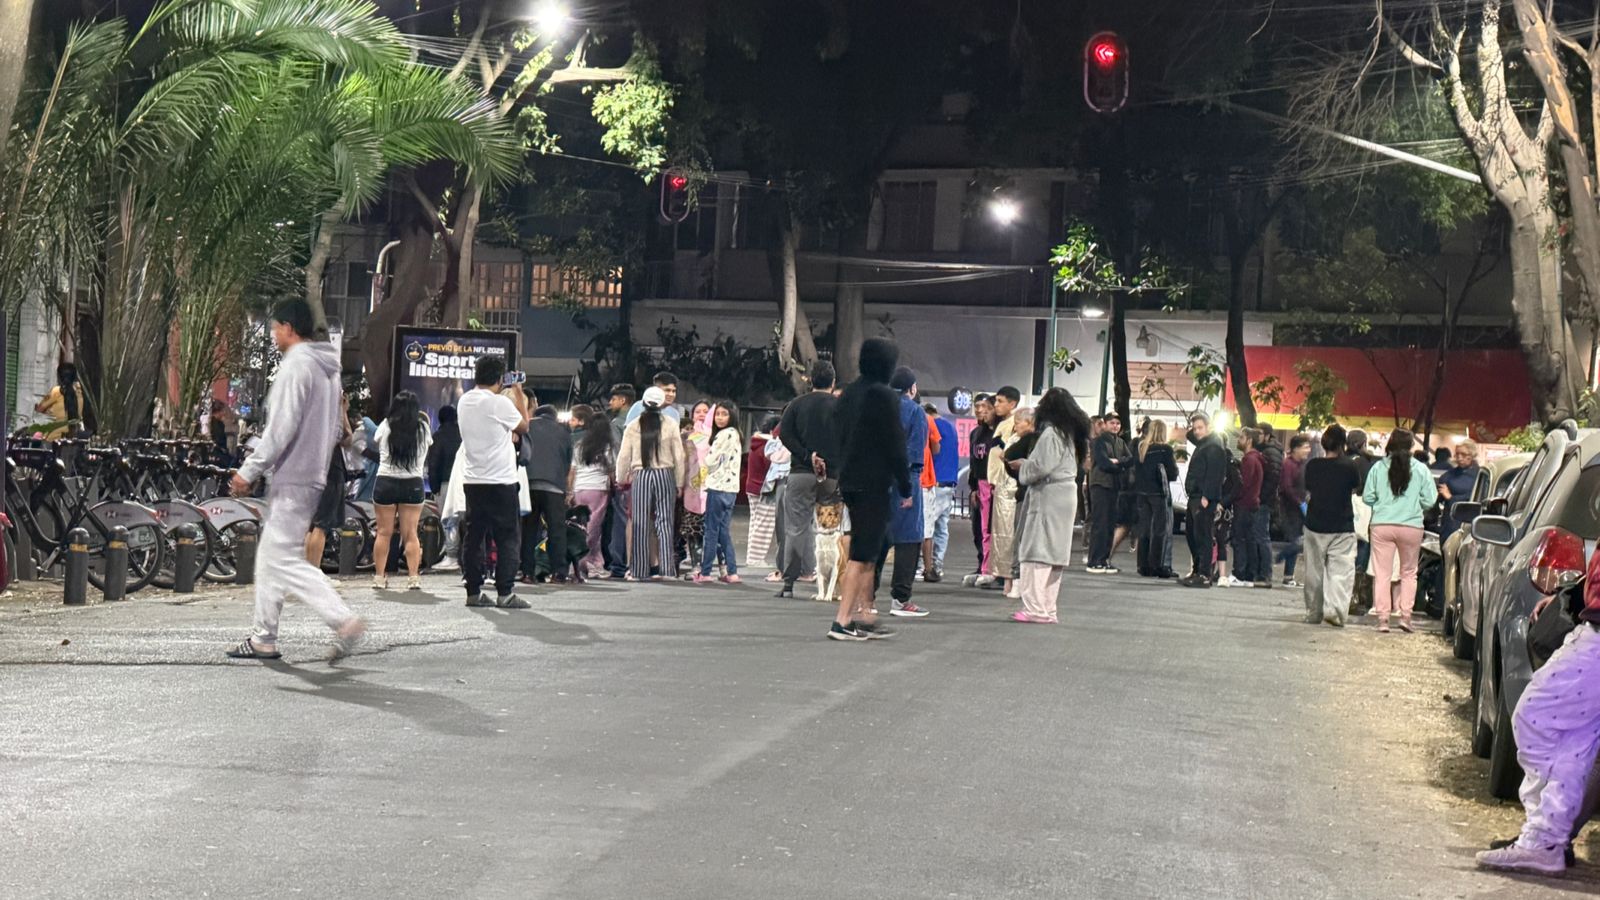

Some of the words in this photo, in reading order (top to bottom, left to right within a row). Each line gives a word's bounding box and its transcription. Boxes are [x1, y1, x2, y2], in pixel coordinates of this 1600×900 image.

[428, 343, 453, 352] PREVIO
[453, 344, 462, 353] DE
[463, 345, 473, 353] LA
[473, 346, 486, 354] NFL
[487, 346, 505, 355] 2025
[425, 352, 481, 367] Sport
